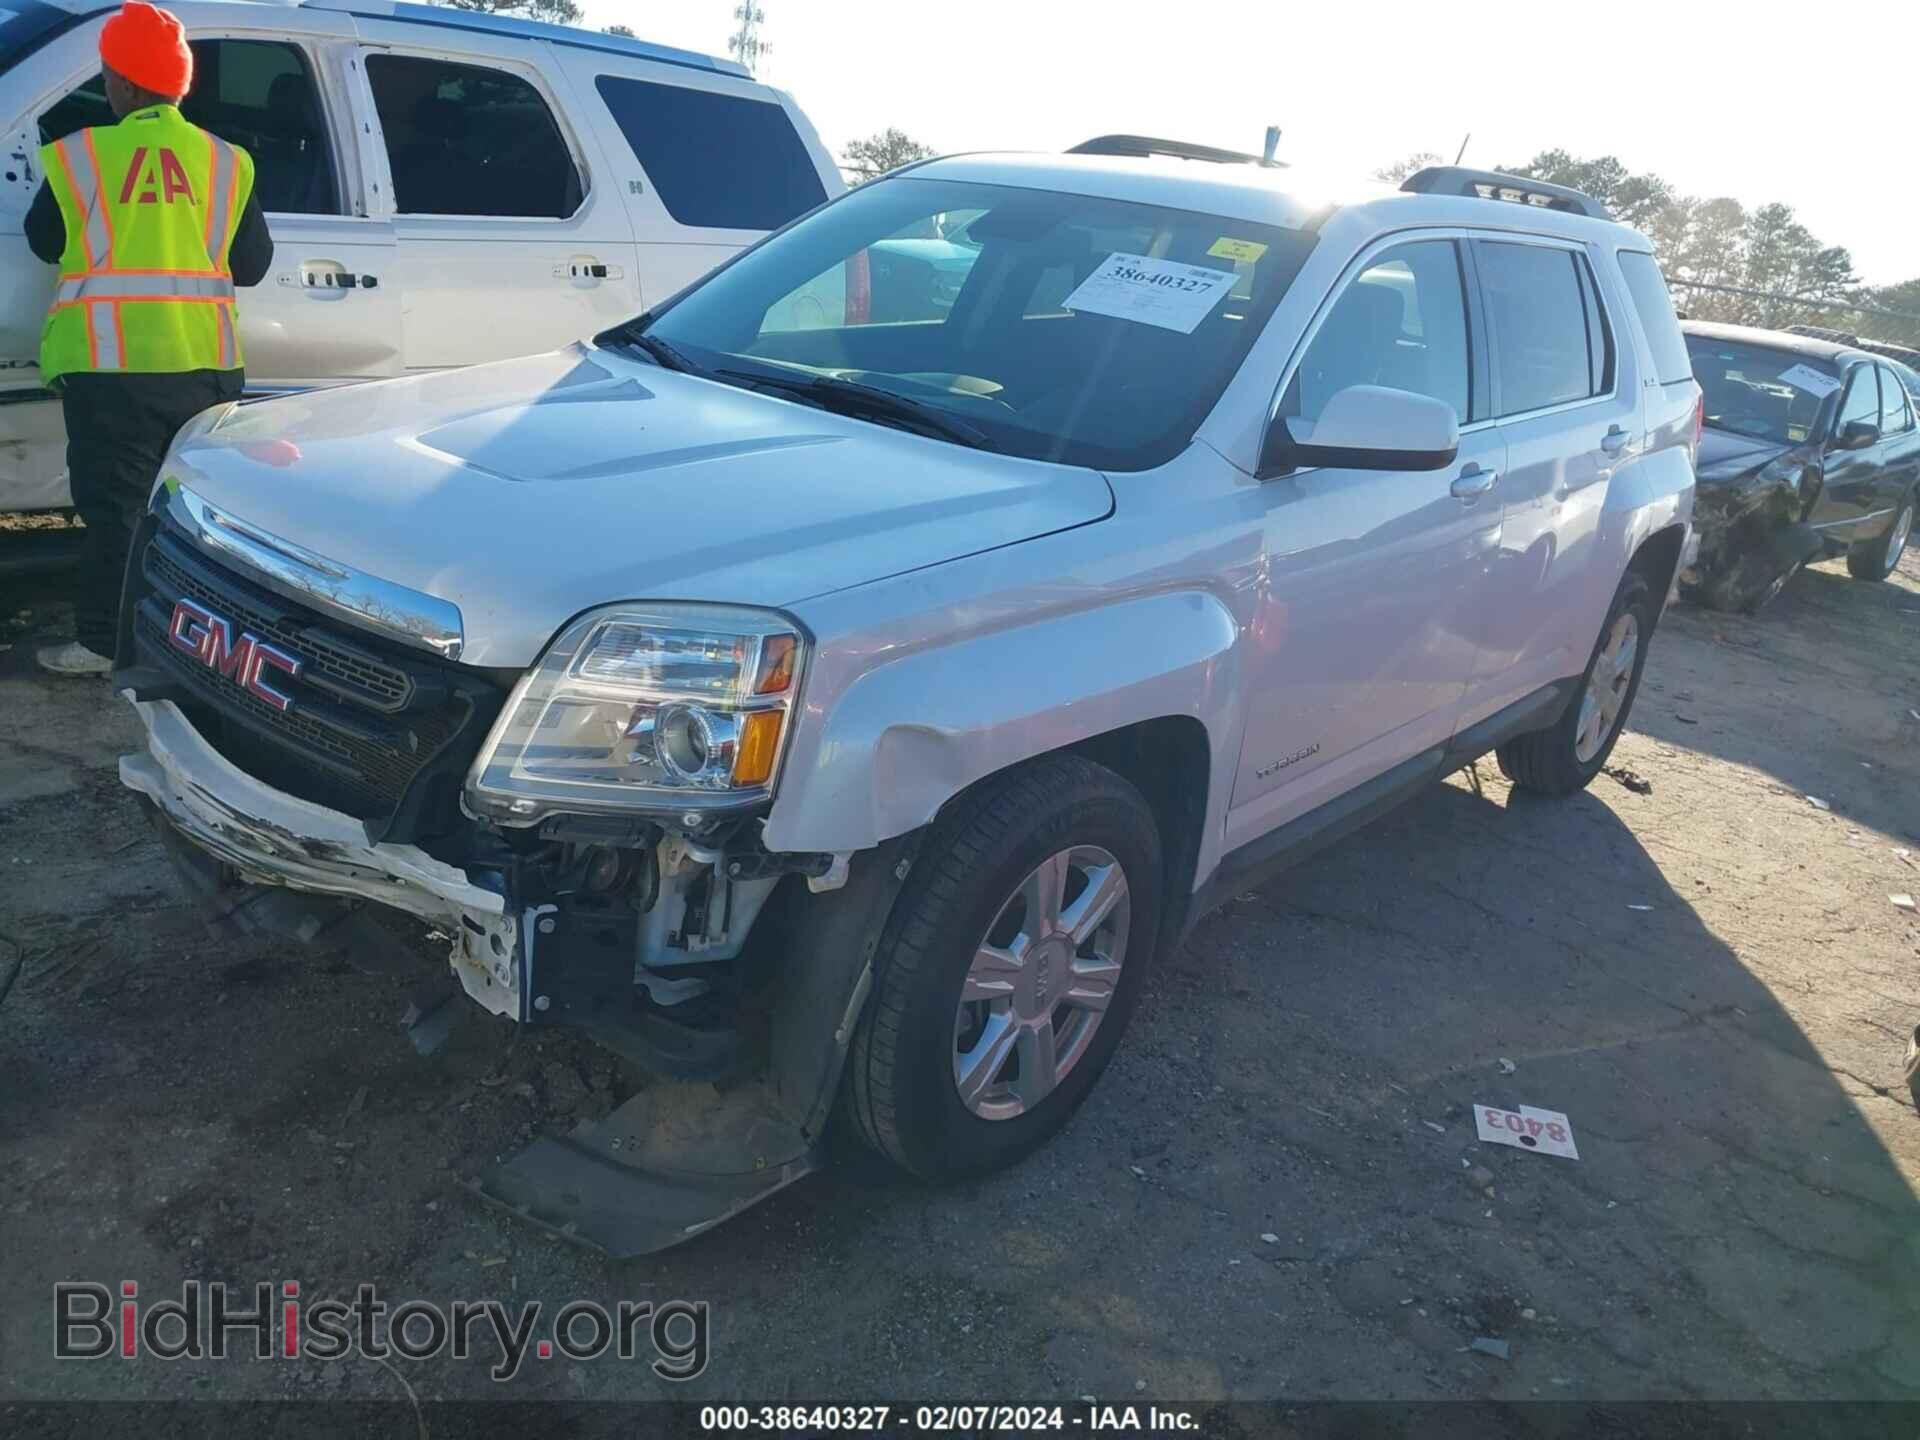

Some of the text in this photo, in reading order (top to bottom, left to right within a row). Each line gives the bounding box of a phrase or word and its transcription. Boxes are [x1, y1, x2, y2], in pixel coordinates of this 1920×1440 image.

[1107, 266, 1213, 294] 38640327
[168, 598, 300, 712] GMC
[1484, 1110, 1567, 1143] 8403
